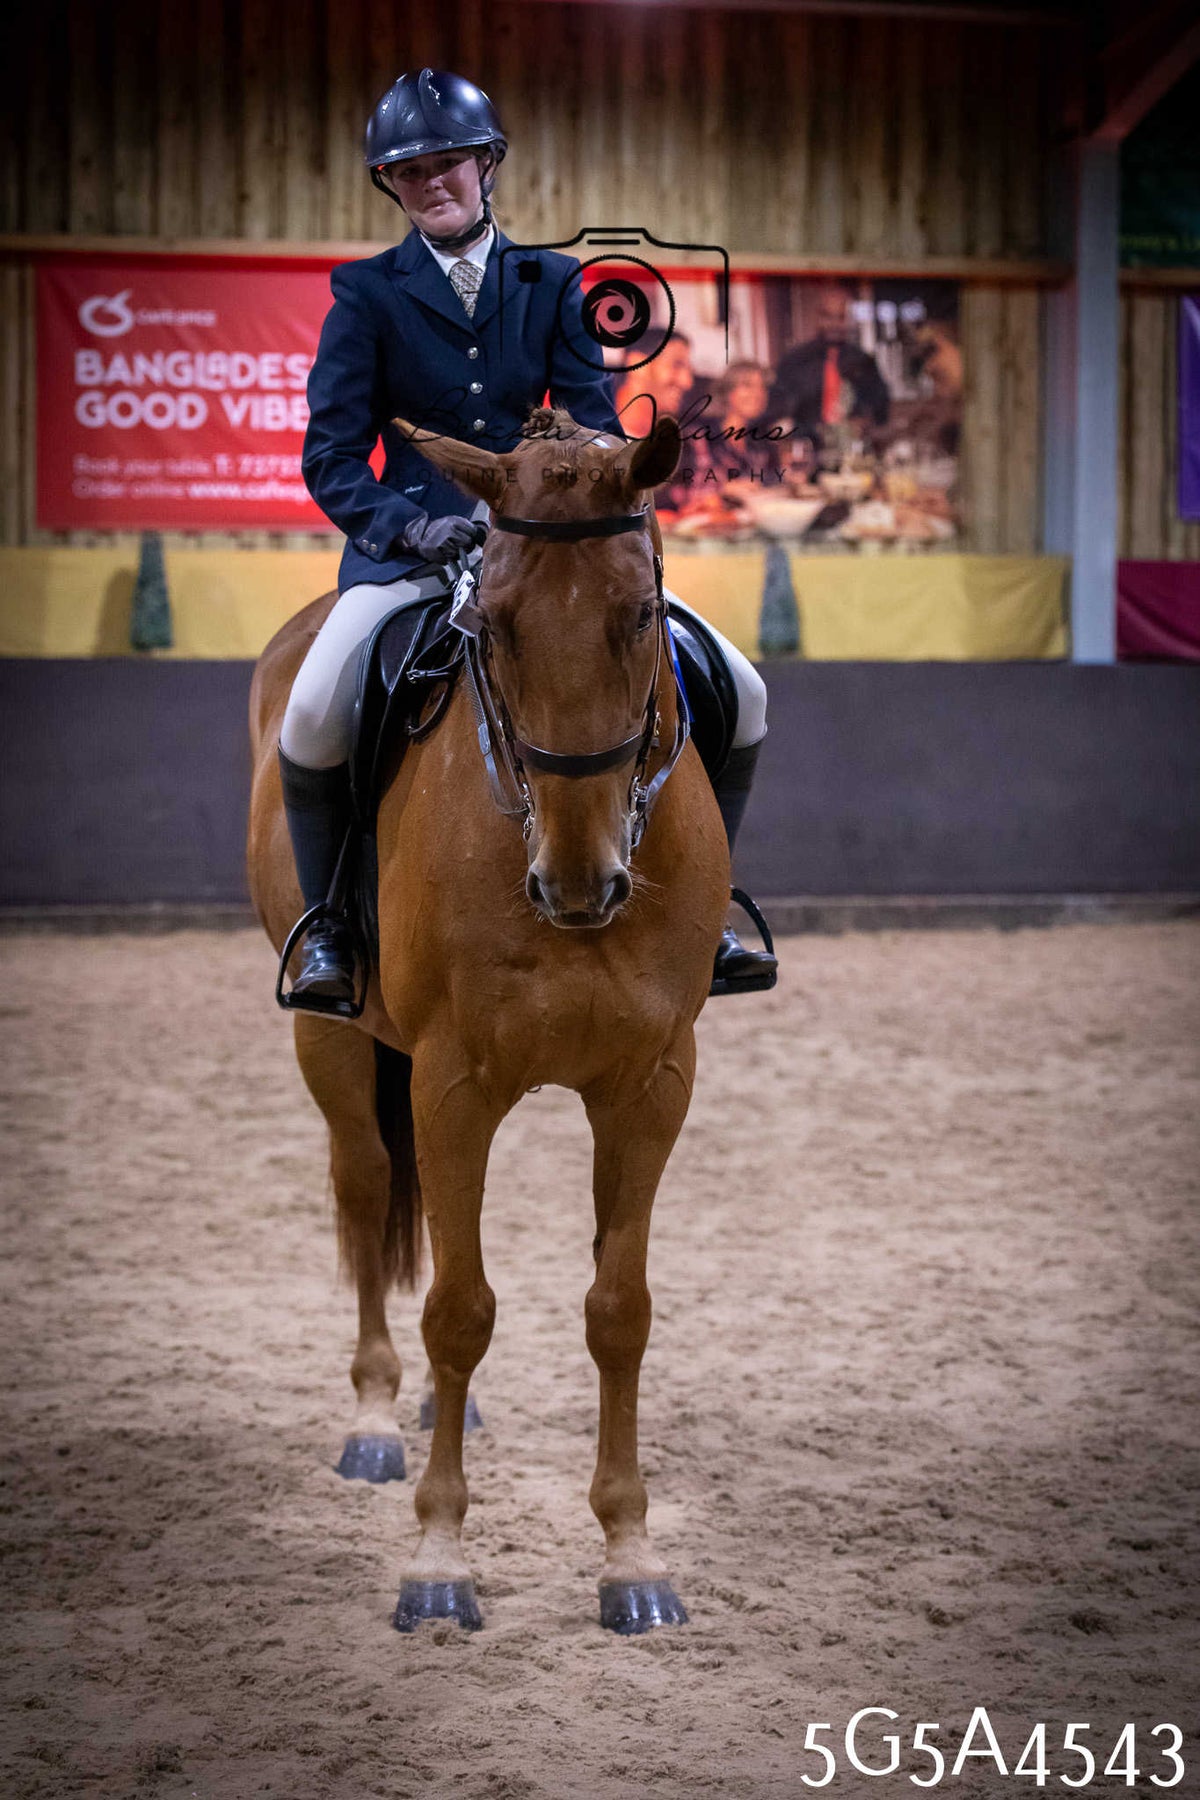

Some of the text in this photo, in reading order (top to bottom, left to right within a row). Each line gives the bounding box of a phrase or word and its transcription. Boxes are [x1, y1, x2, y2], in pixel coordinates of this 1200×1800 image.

[75, 349, 313, 391] BANGLADES
[75, 390, 311, 431] GOOD VIBE
